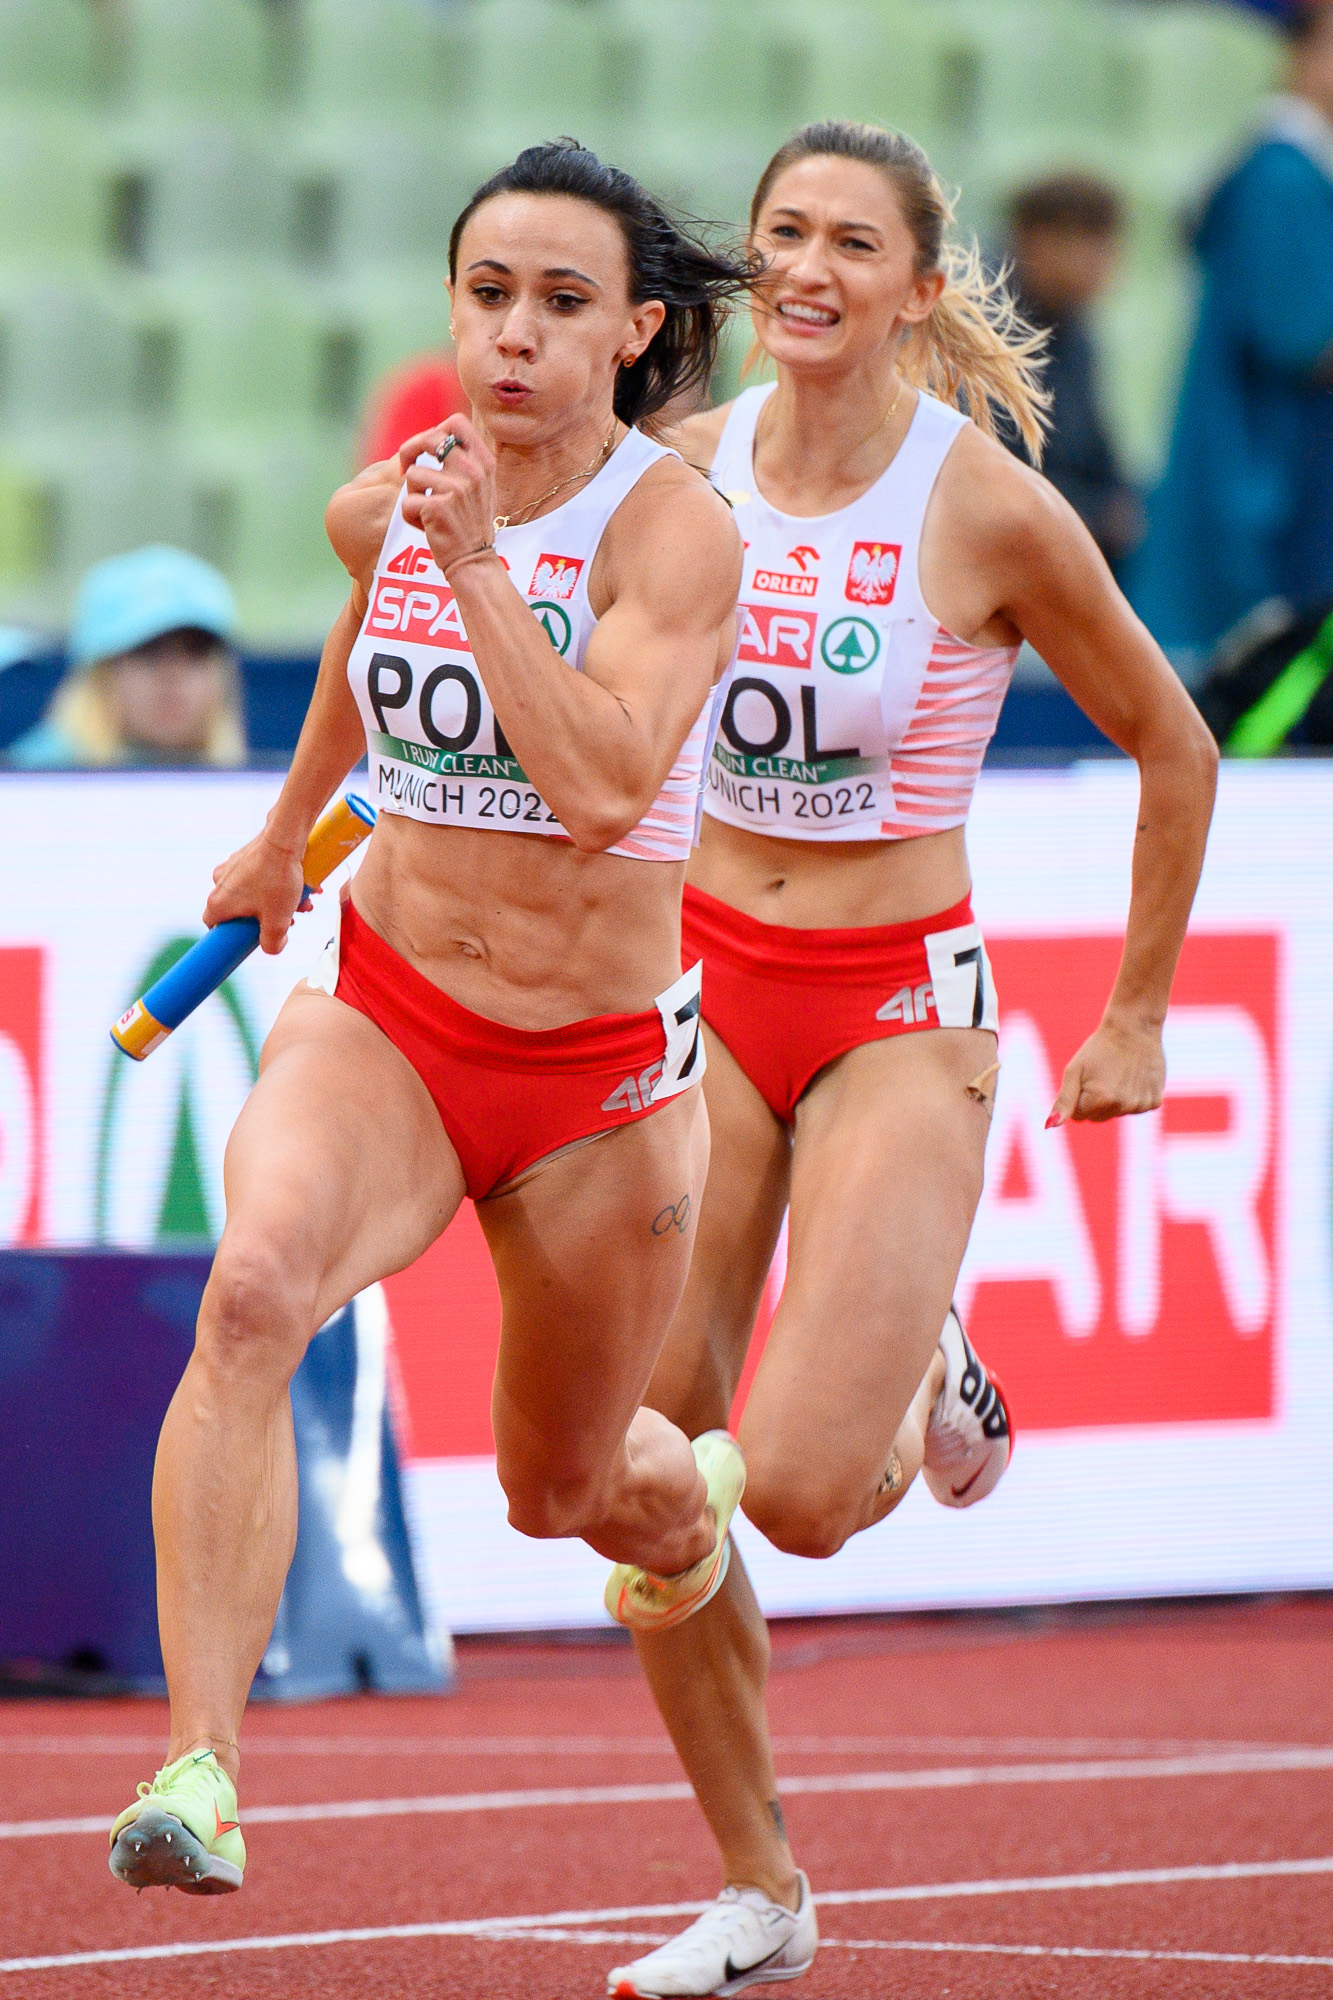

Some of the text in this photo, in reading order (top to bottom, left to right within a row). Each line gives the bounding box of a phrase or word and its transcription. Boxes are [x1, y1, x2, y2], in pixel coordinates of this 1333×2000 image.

[756, 573, 815, 595] ORLEN
[401, 742, 409, 759] I
[410, 745, 440, 769] RUN
[379, 764, 464, 815] MUNICH
[706, 762, 876, 819] UNICH 2022
[953, 946, 984, 1028] 7
[673, 991, 700, 1081] 7
